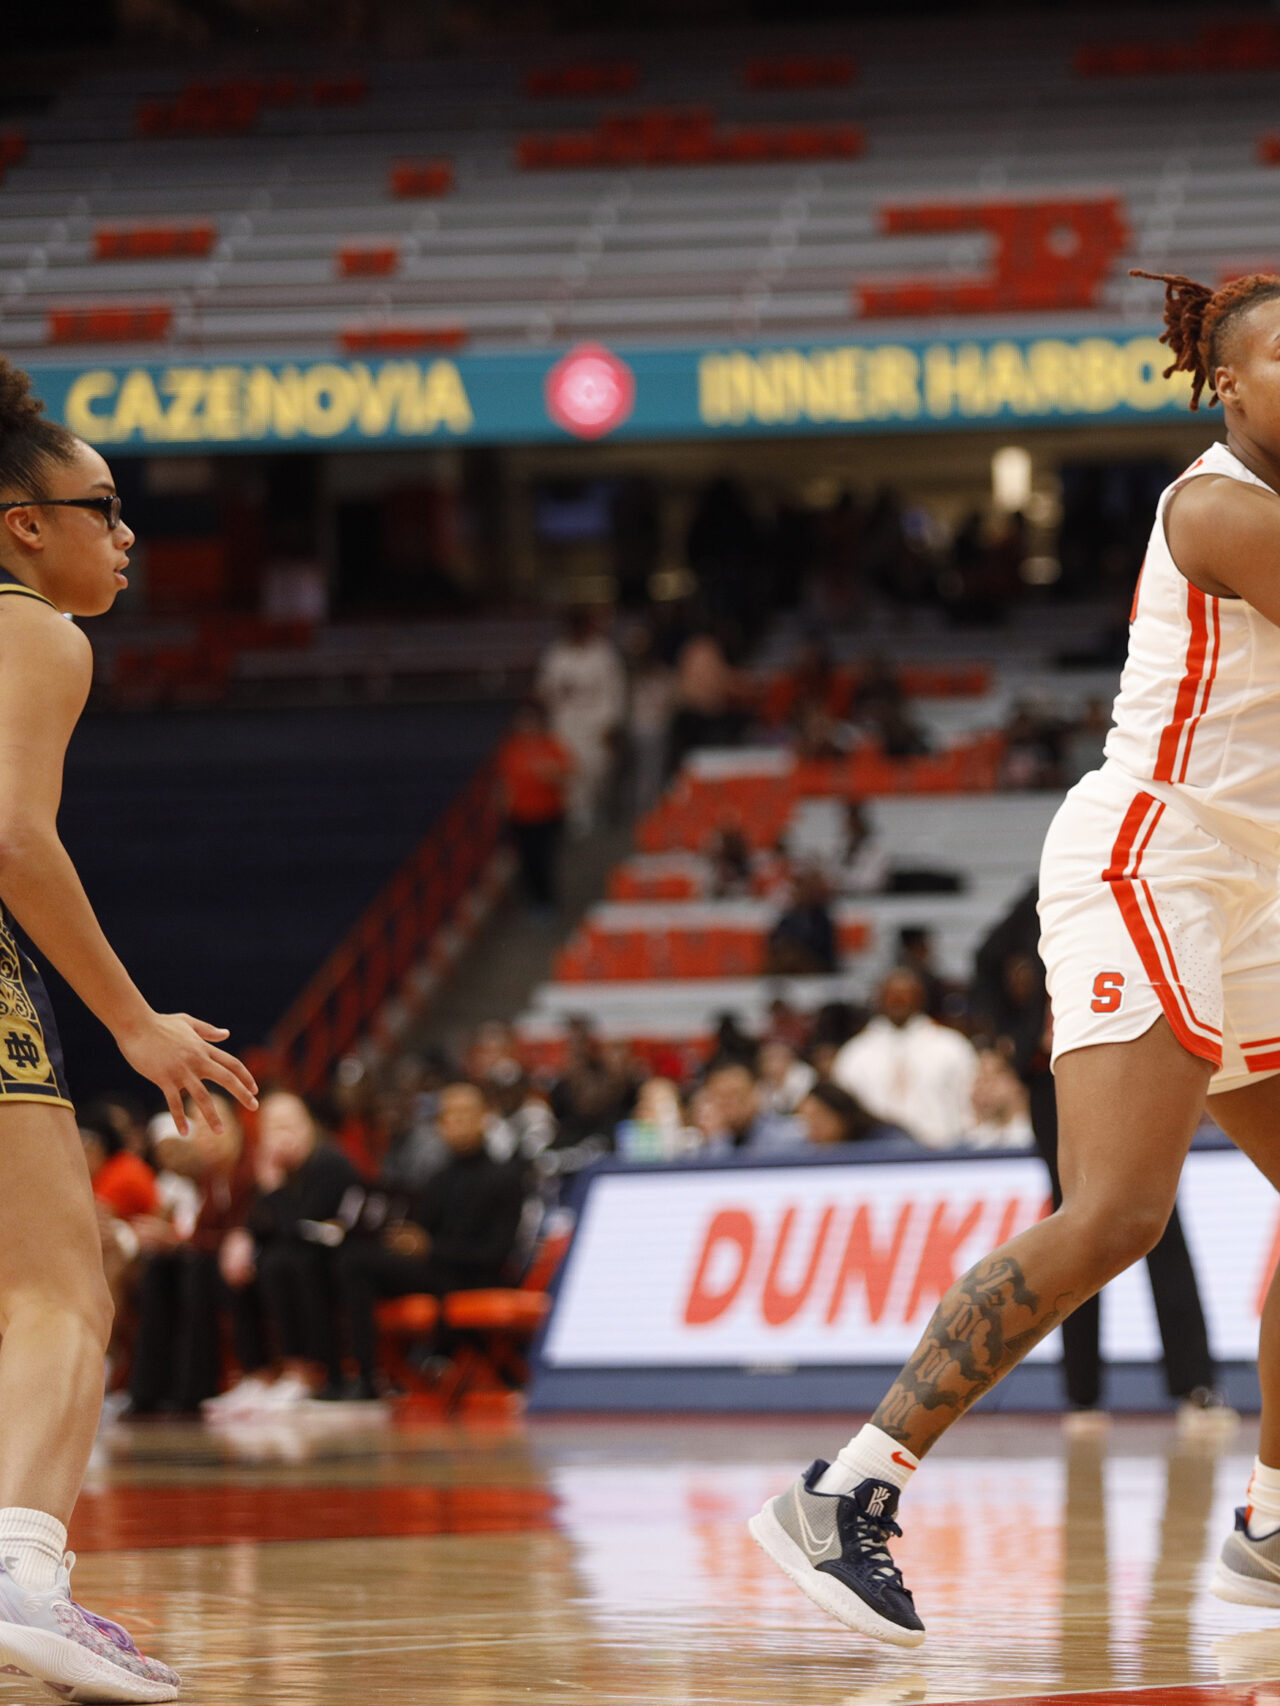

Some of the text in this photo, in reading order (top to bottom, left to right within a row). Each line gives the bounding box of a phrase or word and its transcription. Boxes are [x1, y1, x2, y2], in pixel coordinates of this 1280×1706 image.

[64, 358, 474, 444] CAZENOVIA
[698, 345, 920, 428] INNER
[1089, 970, 1126, 1014] S
